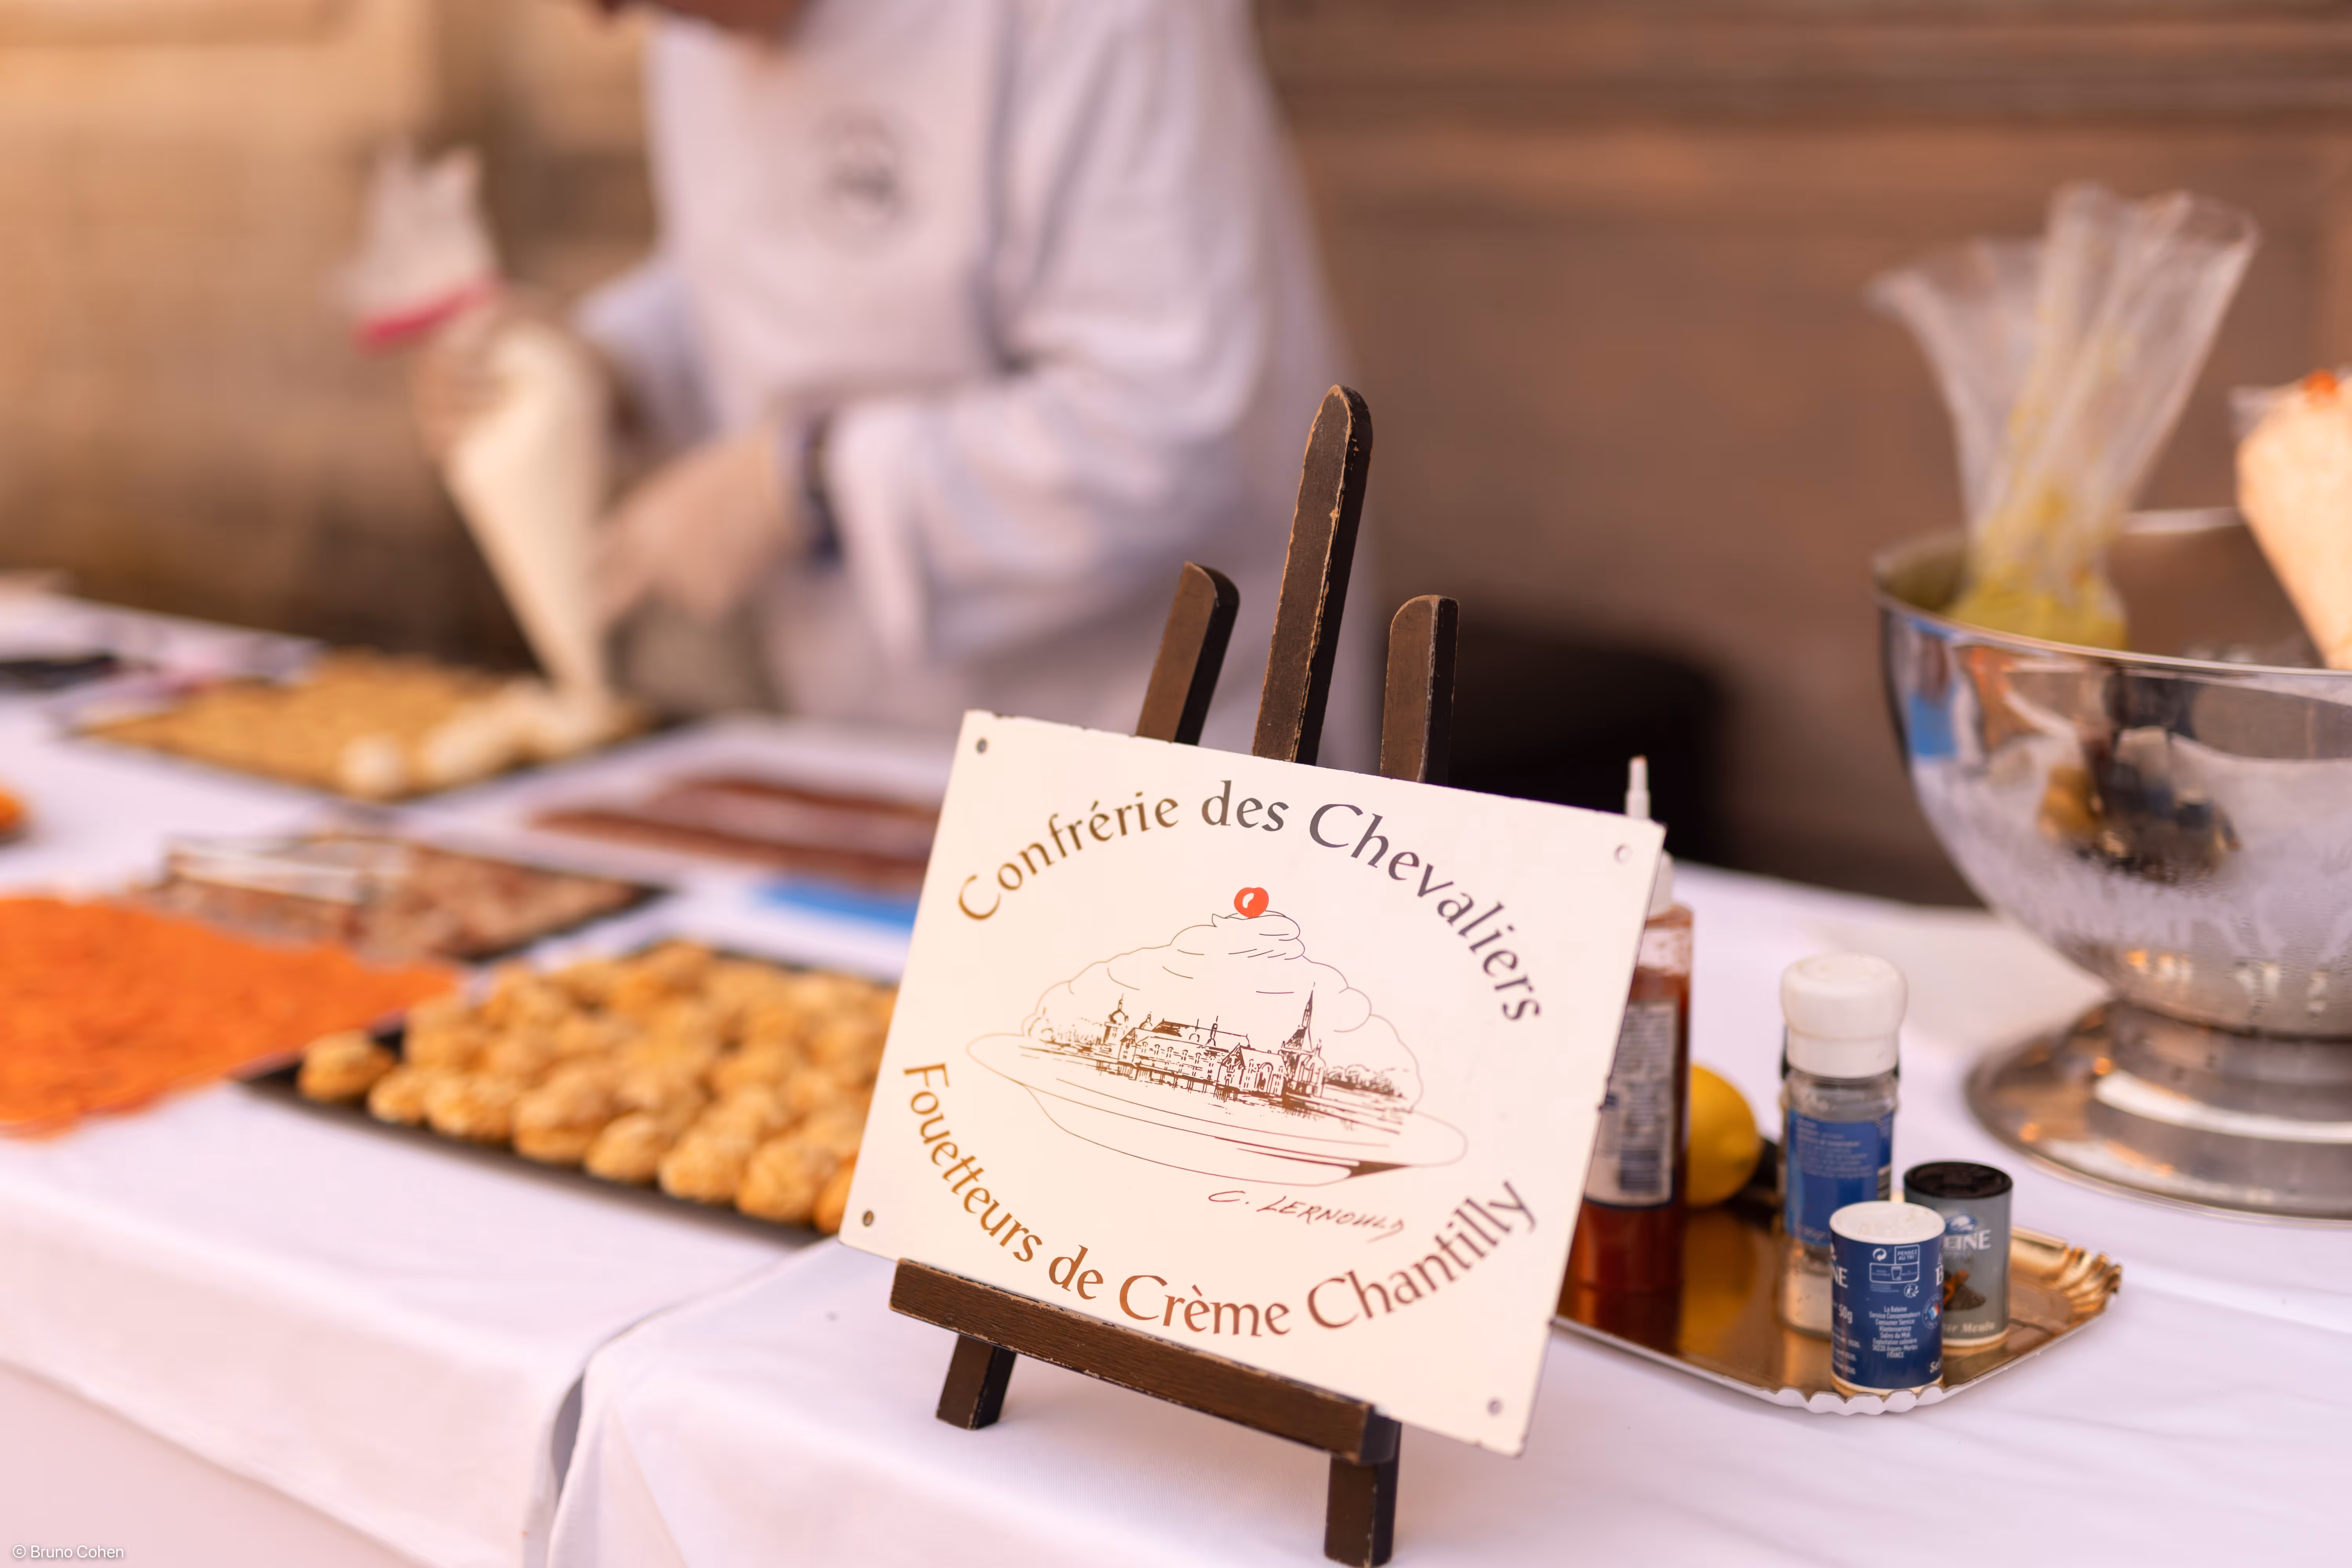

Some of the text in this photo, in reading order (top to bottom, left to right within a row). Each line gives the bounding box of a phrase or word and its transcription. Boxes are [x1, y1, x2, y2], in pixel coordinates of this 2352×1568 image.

[958, 780, 1541, 1020] Confrérie des Chevaliers
[903, 1062, 1537, 1336] Fouetteurs de Crème Chantilly
